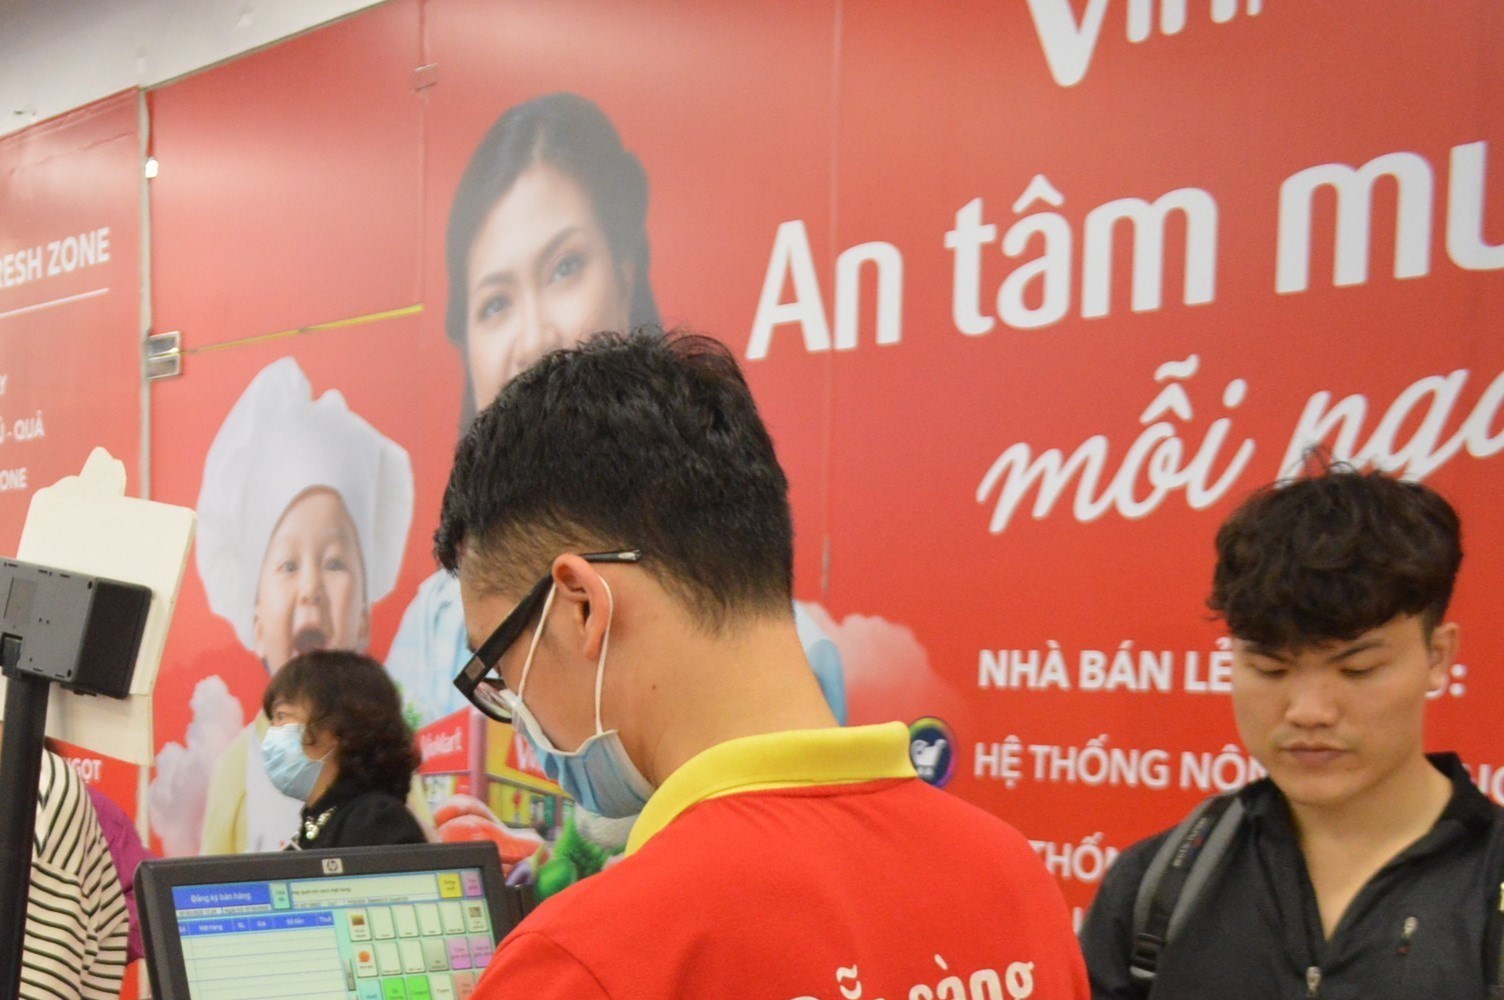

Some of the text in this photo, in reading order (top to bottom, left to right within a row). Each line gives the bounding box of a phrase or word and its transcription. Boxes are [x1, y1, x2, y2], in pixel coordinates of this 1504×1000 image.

[47, 226, 110, 277] ZONE
[745, 219, 903, 360] An
[945, 174, 1218, 337] tâm
[15, 409, 45, 442] QUẢ
[975, 354, 1255, 535] mỗi
[978, 637, 1233, 694] NHÀ BÁN LẺ
[973, 733, 1269, 796] HỆ THỐNG NÔN
